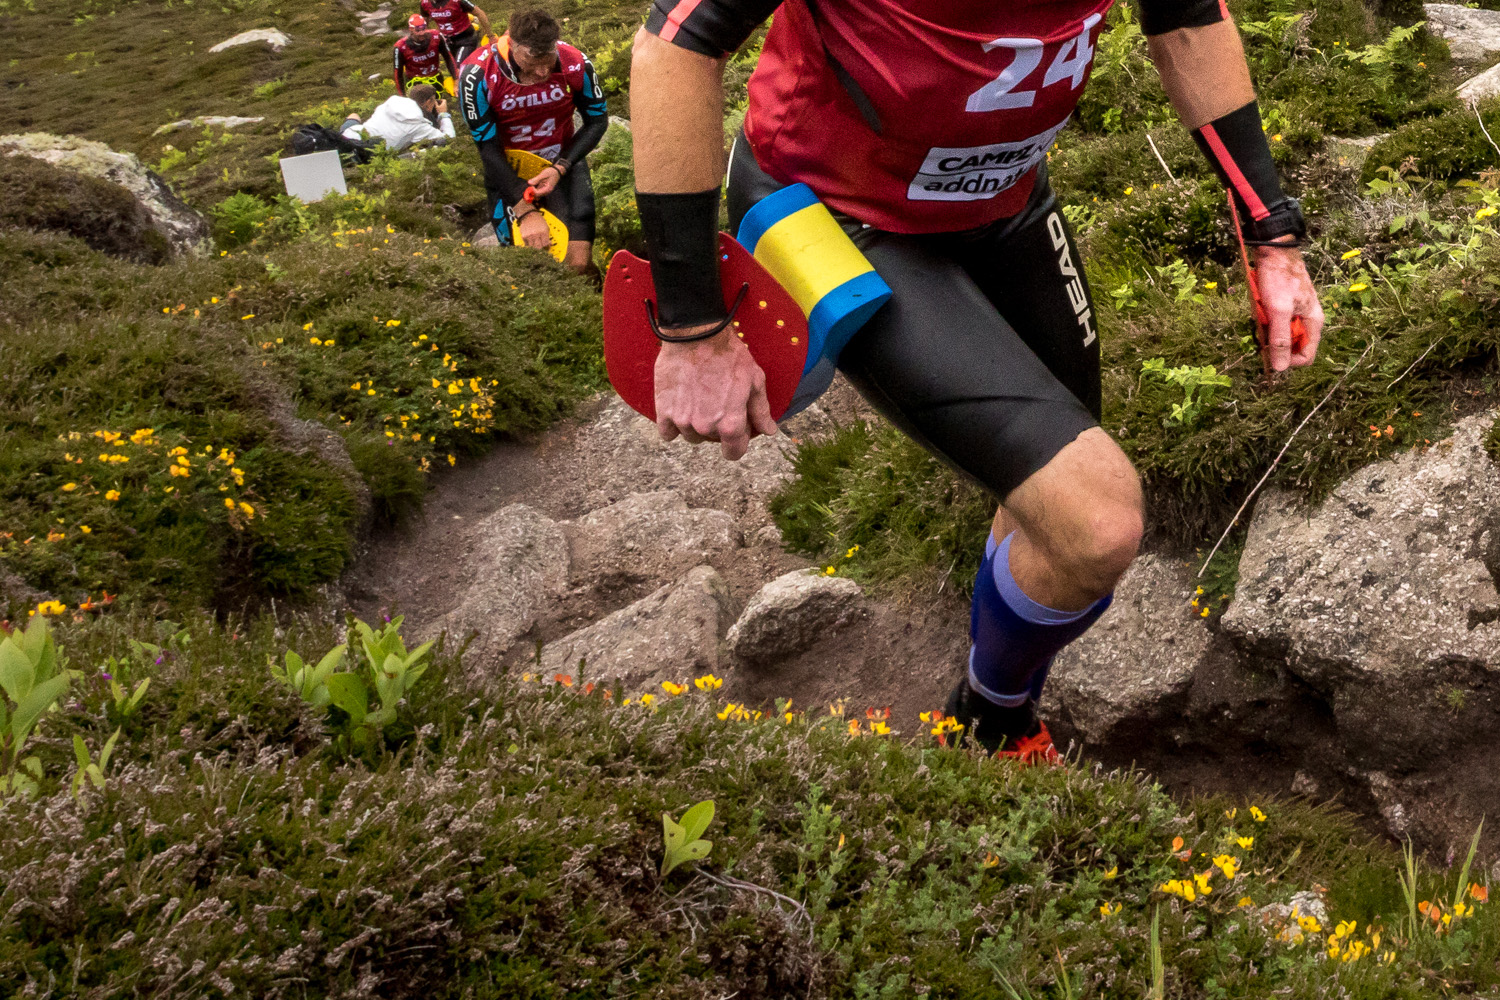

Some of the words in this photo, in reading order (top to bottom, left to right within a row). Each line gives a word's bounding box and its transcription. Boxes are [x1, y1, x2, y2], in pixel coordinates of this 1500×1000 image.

[965, 13, 1102, 112] 24
[501, 84, 565, 110] ÖTILLÖ
[509, 118, 556, 143] 24
[938, 143, 1035, 172] CAMPZ
[1047, 212, 1096, 347] HEAD
